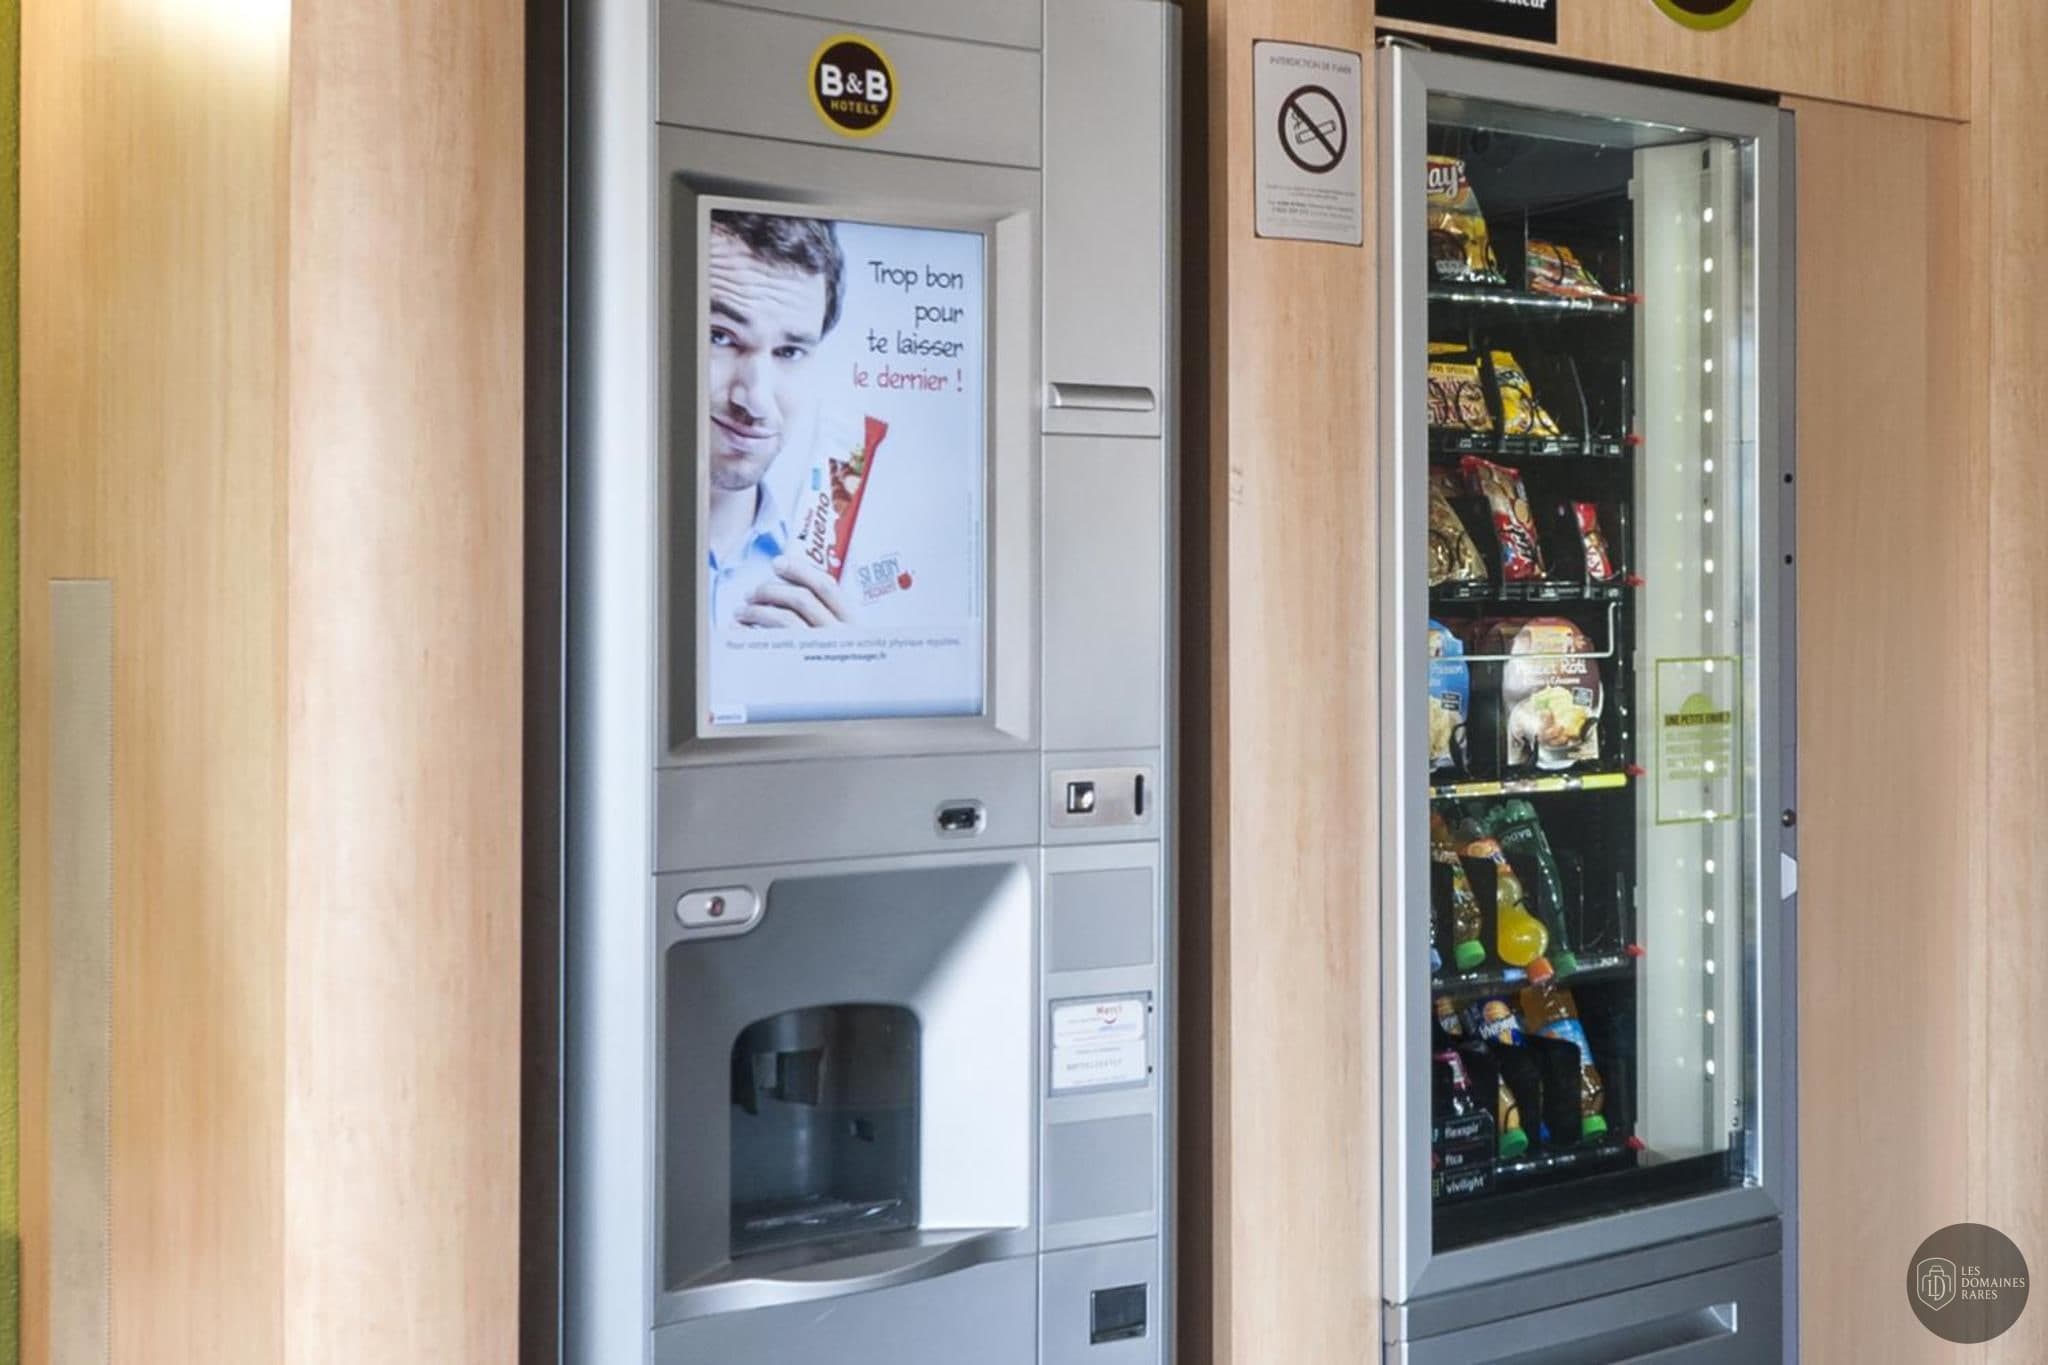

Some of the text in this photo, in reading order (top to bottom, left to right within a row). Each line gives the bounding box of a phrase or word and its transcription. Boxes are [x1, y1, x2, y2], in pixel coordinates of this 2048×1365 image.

[821, 64, 889, 102] B&B
[831, 100, 879, 116] HOTELS
[868, 261, 963, 293] Trop bon
[915, 305, 964, 329] pour
[866, 328, 964, 358] te laisser
[853, 362, 869, 389] le
[877, 364, 948, 391] dernier
[806, 493, 830, 564] bueno
